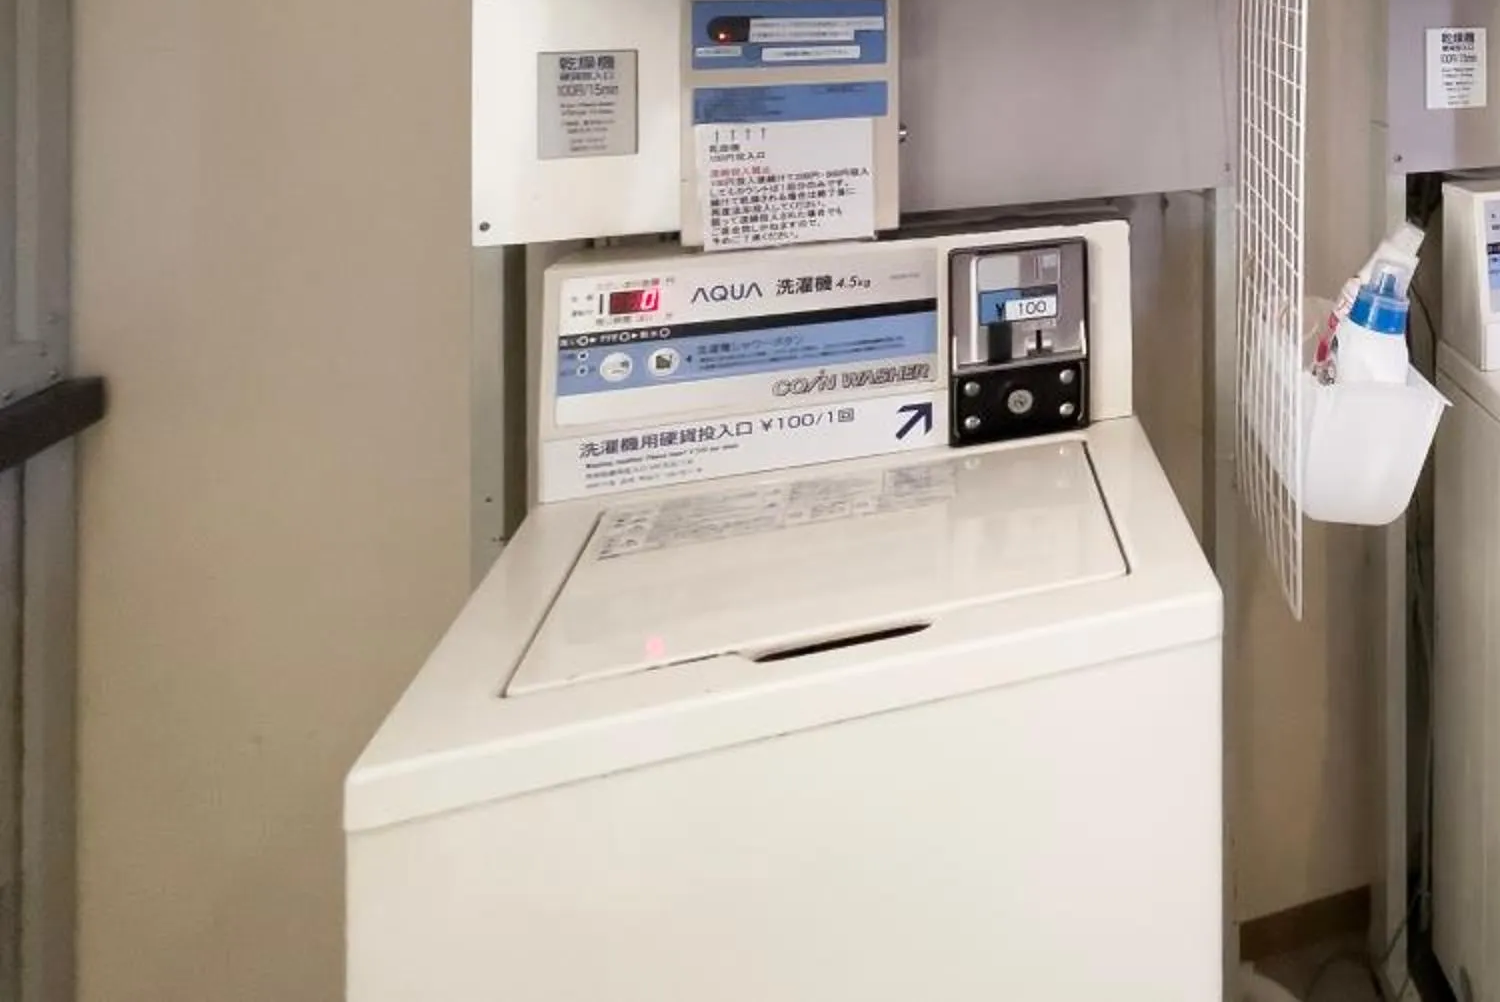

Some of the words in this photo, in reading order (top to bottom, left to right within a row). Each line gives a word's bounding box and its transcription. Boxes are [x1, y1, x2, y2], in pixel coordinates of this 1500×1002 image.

[691, 281, 764, 305] AQUA
[775, 275, 833, 297] 洗濯機
[835, 274, 872, 290] 4.5kg
[1018, 300, 1047, 316] 100
[578, 421, 752, 459] 洗濯機用硬貨投入口
[760, 406, 856, 433] ¥100/1回
